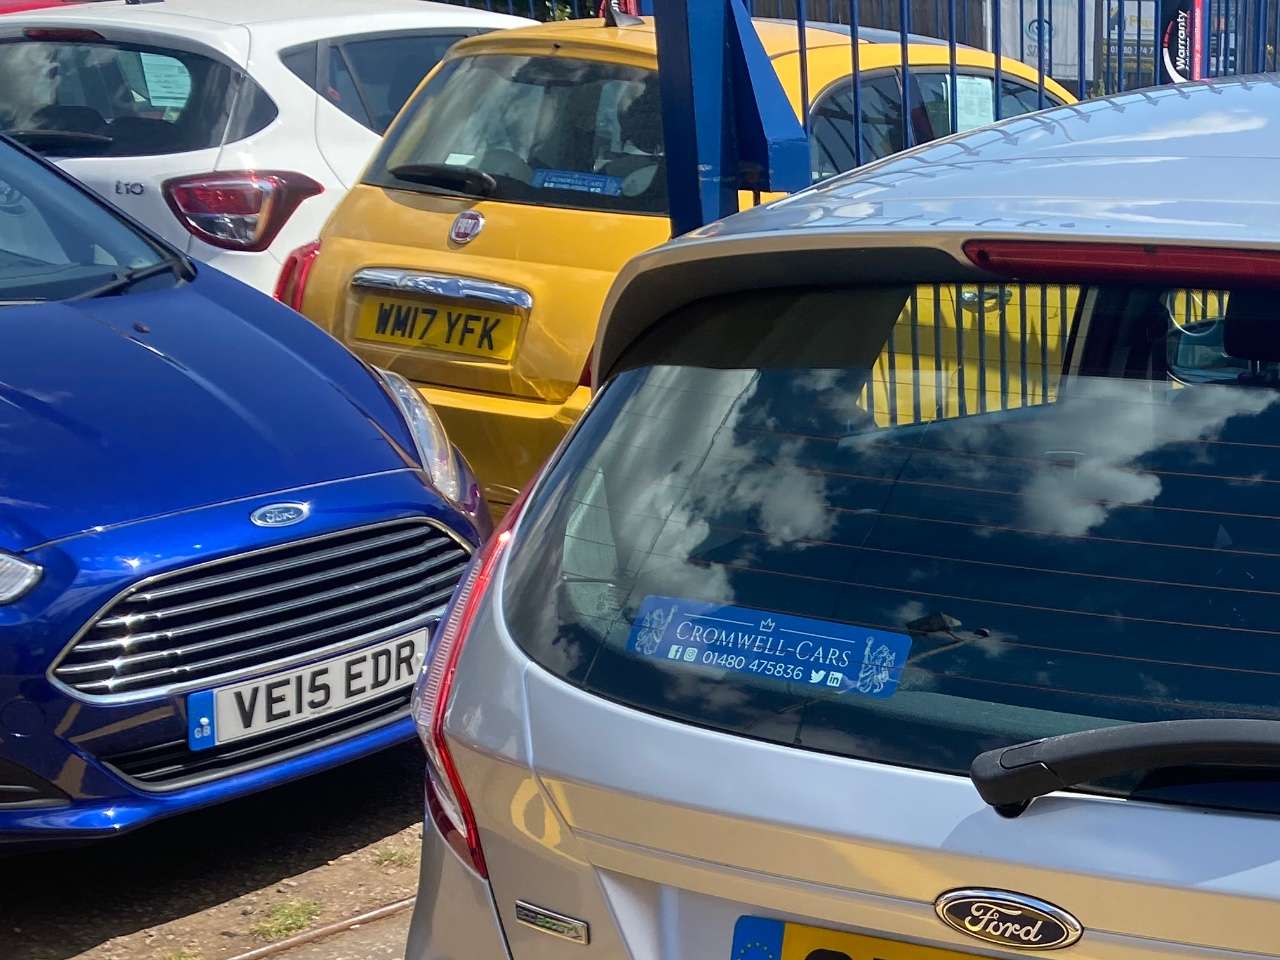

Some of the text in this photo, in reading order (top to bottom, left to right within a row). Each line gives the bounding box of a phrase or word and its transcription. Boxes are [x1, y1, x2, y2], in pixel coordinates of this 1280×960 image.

[1176, 10, 1188, 70] Warranty
[375, 302, 500, 350] WM17 YFK
[233, 640, 416, 729] VE15 EDR
[702, 650, 745, 670] 01480
[748, 659, 804, 681] 475836
[194, 725, 212, 739] GB
[964, 902, 1043, 943] Ford
